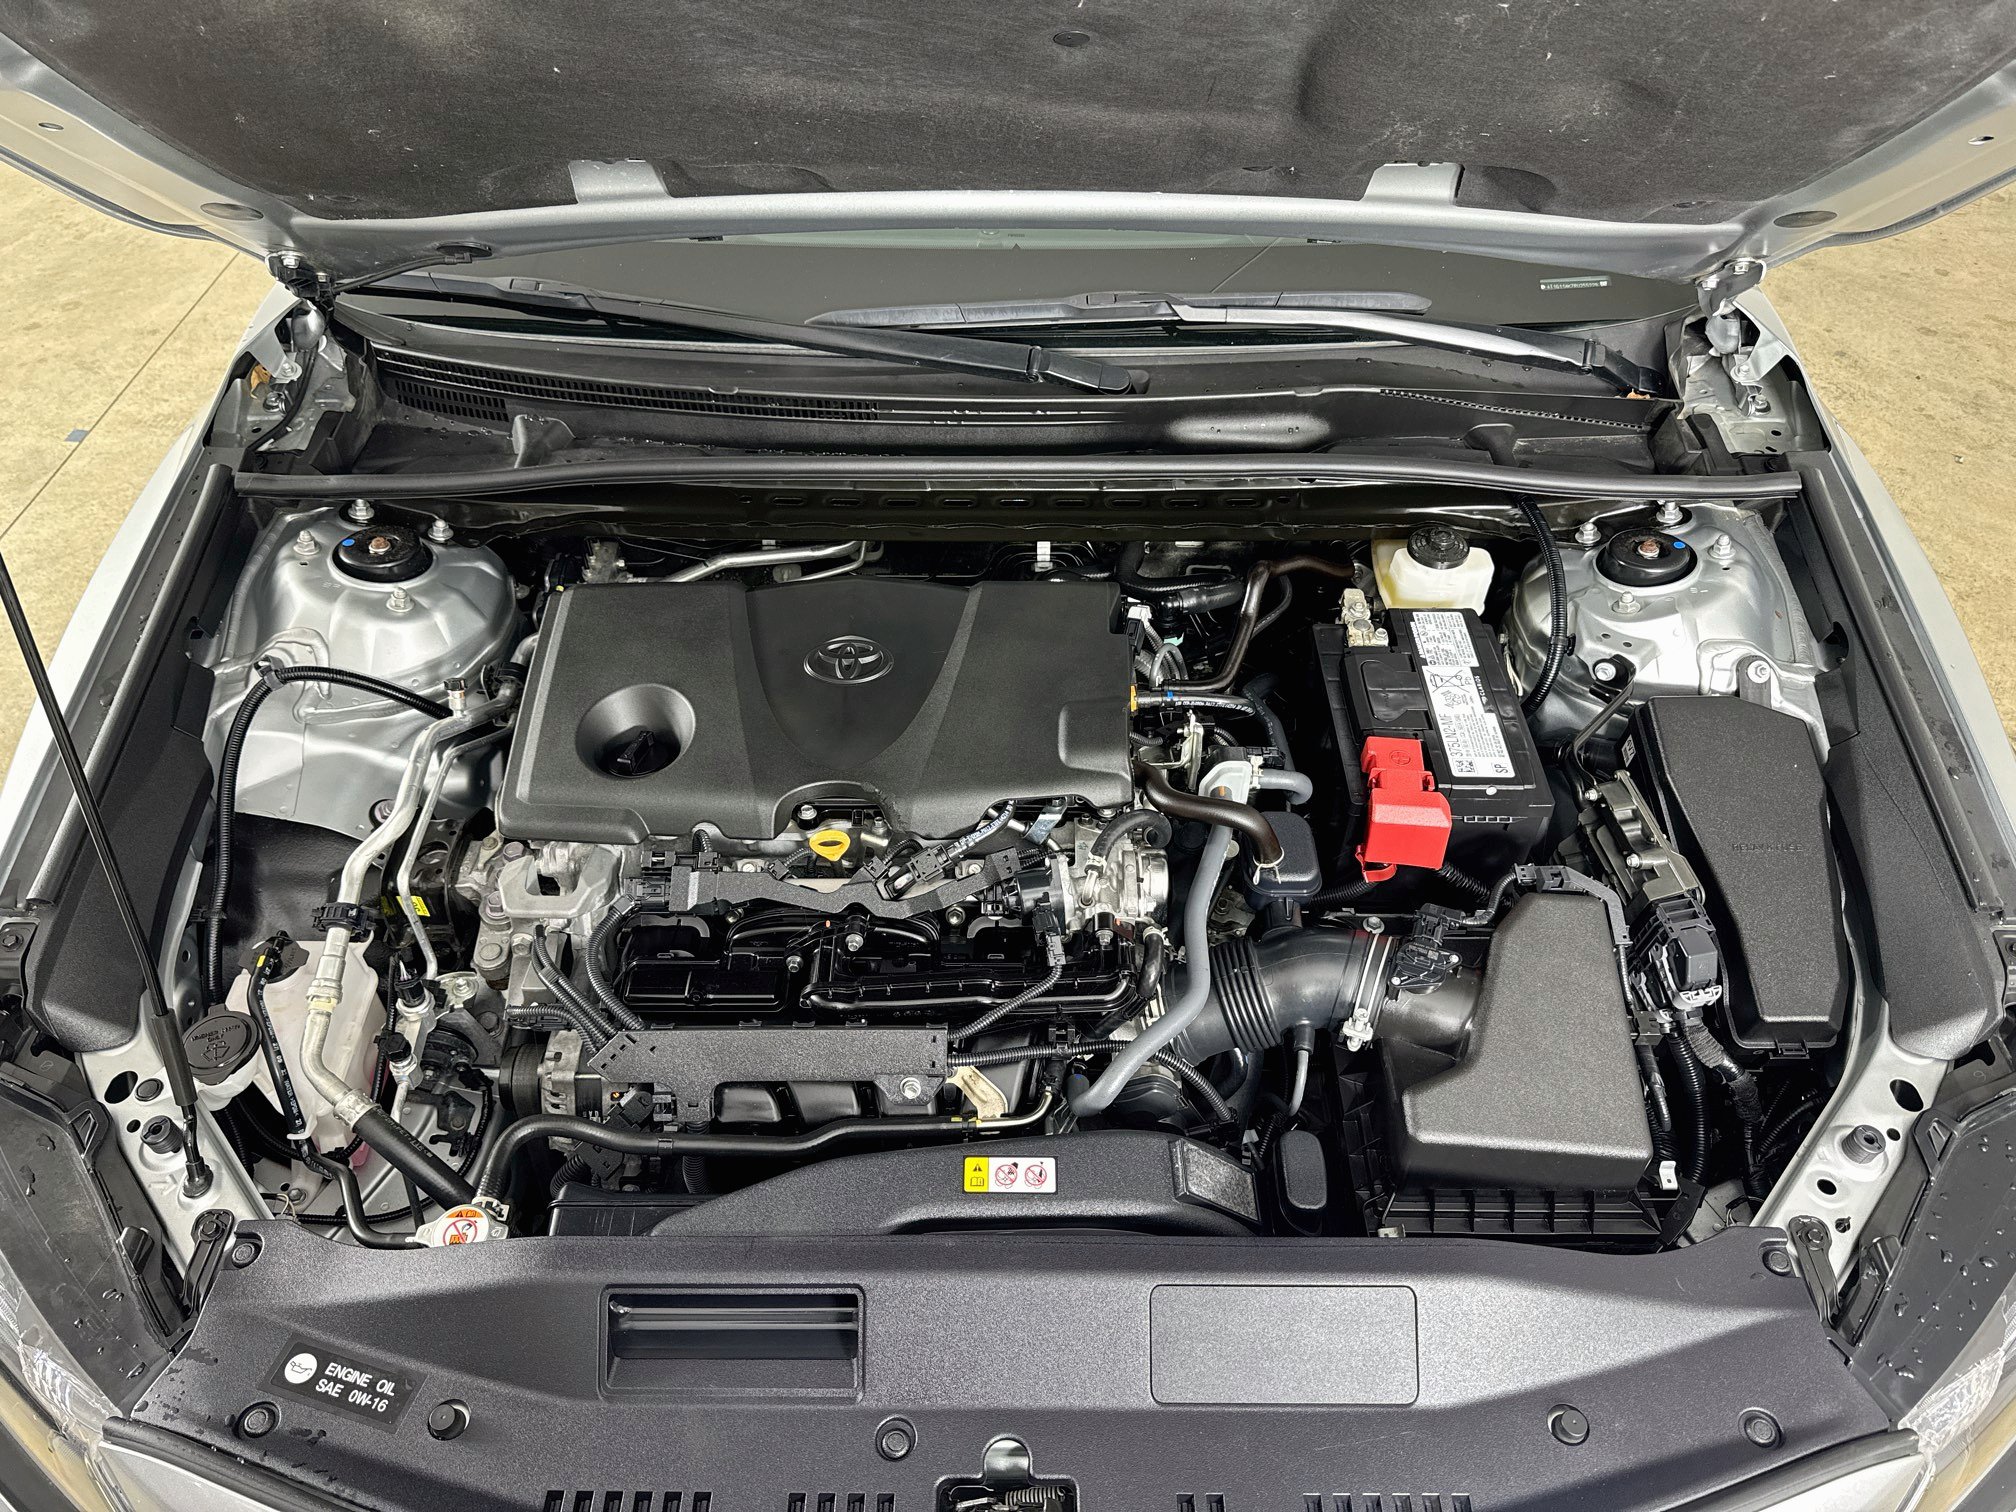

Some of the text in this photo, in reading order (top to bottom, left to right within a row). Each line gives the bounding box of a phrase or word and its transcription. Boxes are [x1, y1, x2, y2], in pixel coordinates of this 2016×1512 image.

[1438, 713, 1463, 757] 375LN2-MF
[1495, 763, 1508, 774] SP
[315, 1379, 389, 1412] SAE 0W-16
[325, 1362, 396, 1397] ENGINE OIL
